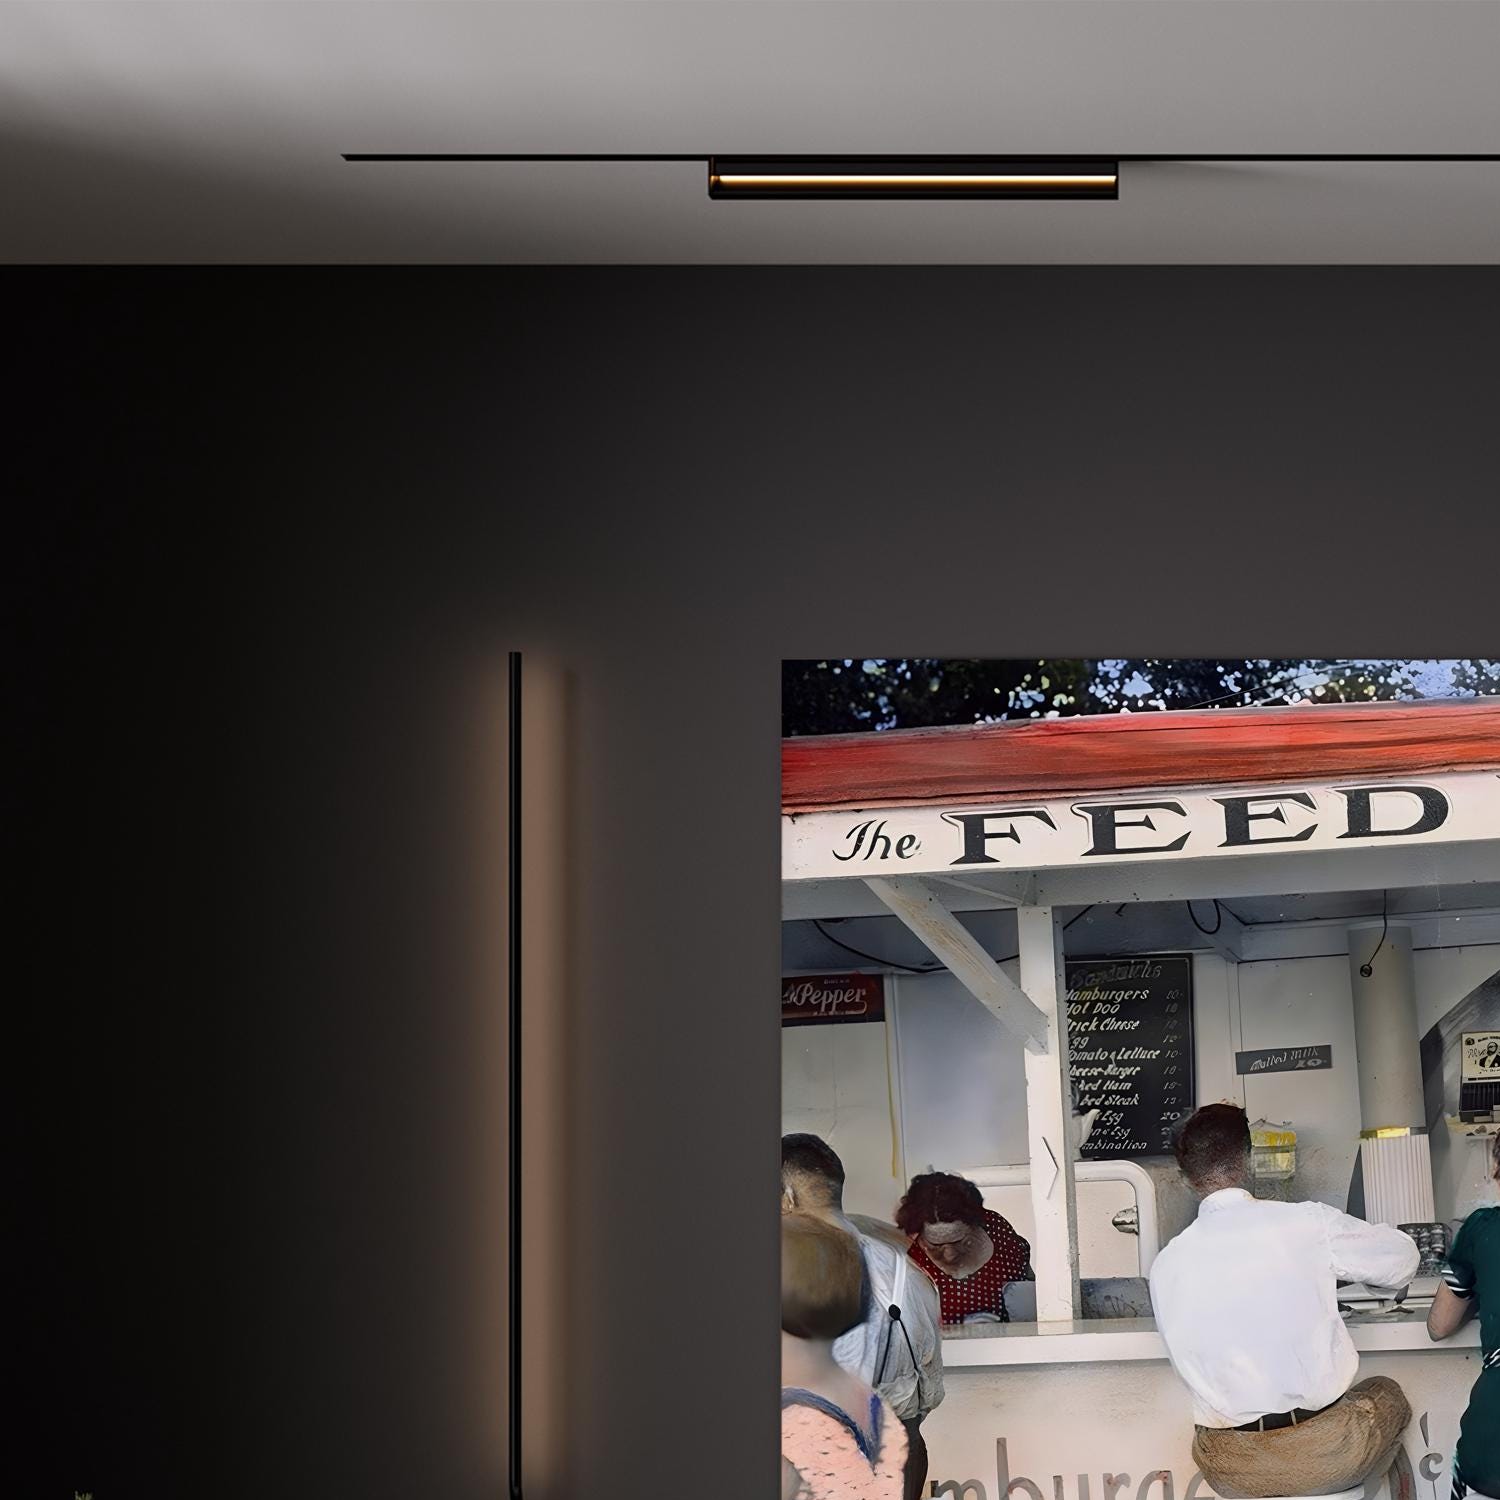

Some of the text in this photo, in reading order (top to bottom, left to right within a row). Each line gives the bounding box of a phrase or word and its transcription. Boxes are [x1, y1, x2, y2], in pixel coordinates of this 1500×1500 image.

[832, 819, 921, 861] The
[942, 784, 1452, 866] FEED
[793, 981, 867, 1015] Pepper
[1069, 1048, 1109, 1061] omato
[1079, 1079, 1102, 1091] ked
[1081, 1139, 1148, 1151] mbination
